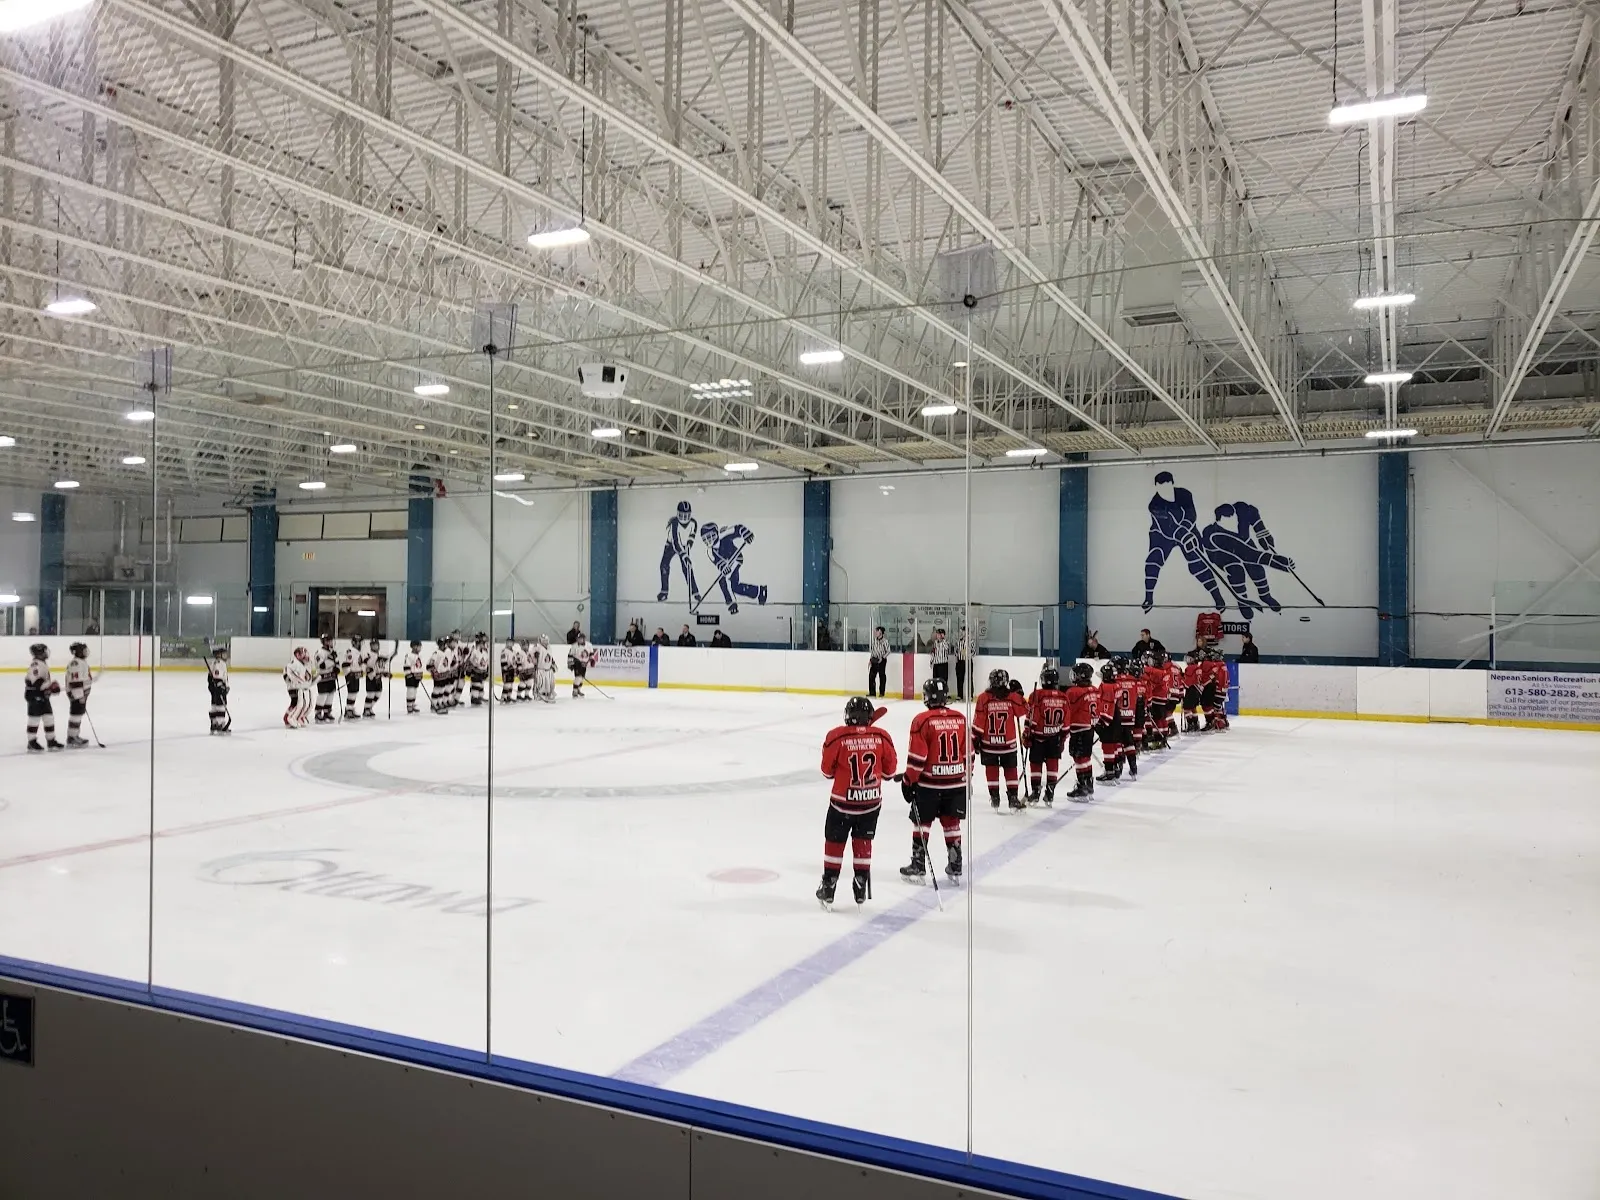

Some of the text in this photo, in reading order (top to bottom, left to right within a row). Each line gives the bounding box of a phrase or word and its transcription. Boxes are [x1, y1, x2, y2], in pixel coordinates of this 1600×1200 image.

[700, 616, 715, 624] HOME
[1224, 624, 1247, 632] ITORS
[600, 648, 646, 658] MYERS.ca
[1490, 674, 1520, 682] Nepean
[1553, 676, 1597, 684] Recreation
[1505, 688, 1600, 699] 613-580-2828, ext.
[1121, 689, 1130, 709] 8
[1518, 704, 1549, 712] pamphlet
[987, 711, 1009, 735] 17
[990, 736, 1006, 744] HALL
[938, 731, 960, 763] 11
[848, 751, 878, 788] 12
[847, 786, 880, 801] LAYCOCK
